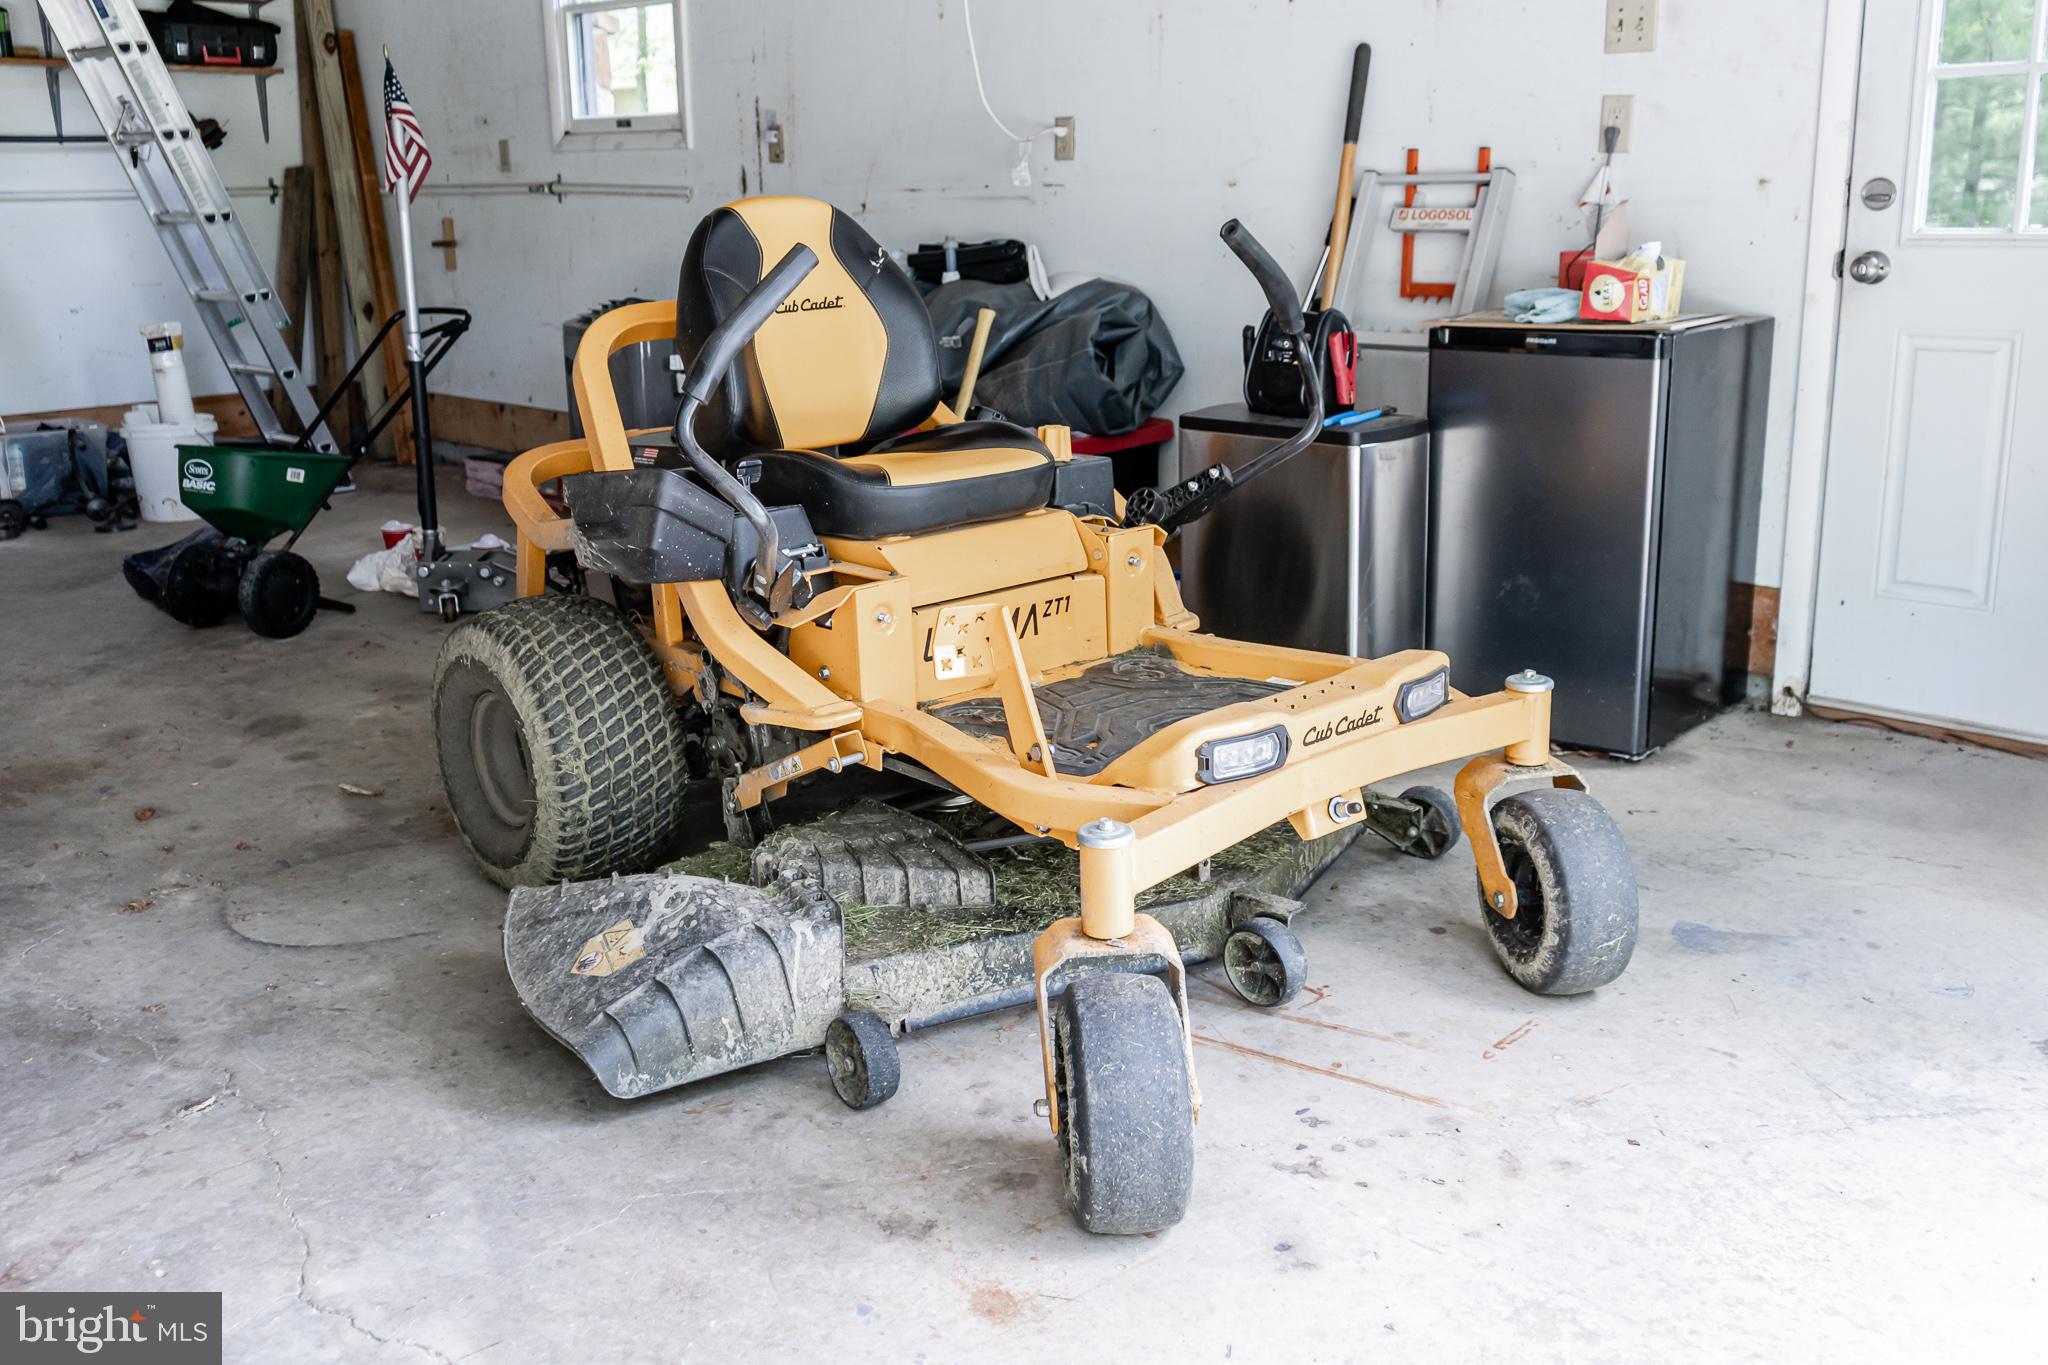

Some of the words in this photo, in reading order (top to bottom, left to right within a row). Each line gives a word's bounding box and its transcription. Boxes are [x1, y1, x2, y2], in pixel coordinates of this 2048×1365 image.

[1411, 209, 1472, 221] LOGOSOL
[801, 295, 844, 311] Cadet
[182, 478, 216, 491] BASIC
[1043, 595, 1071, 618] ZT1
[1303, 726, 1333, 746] Cub
[1335, 705, 1383, 735] Cadet
